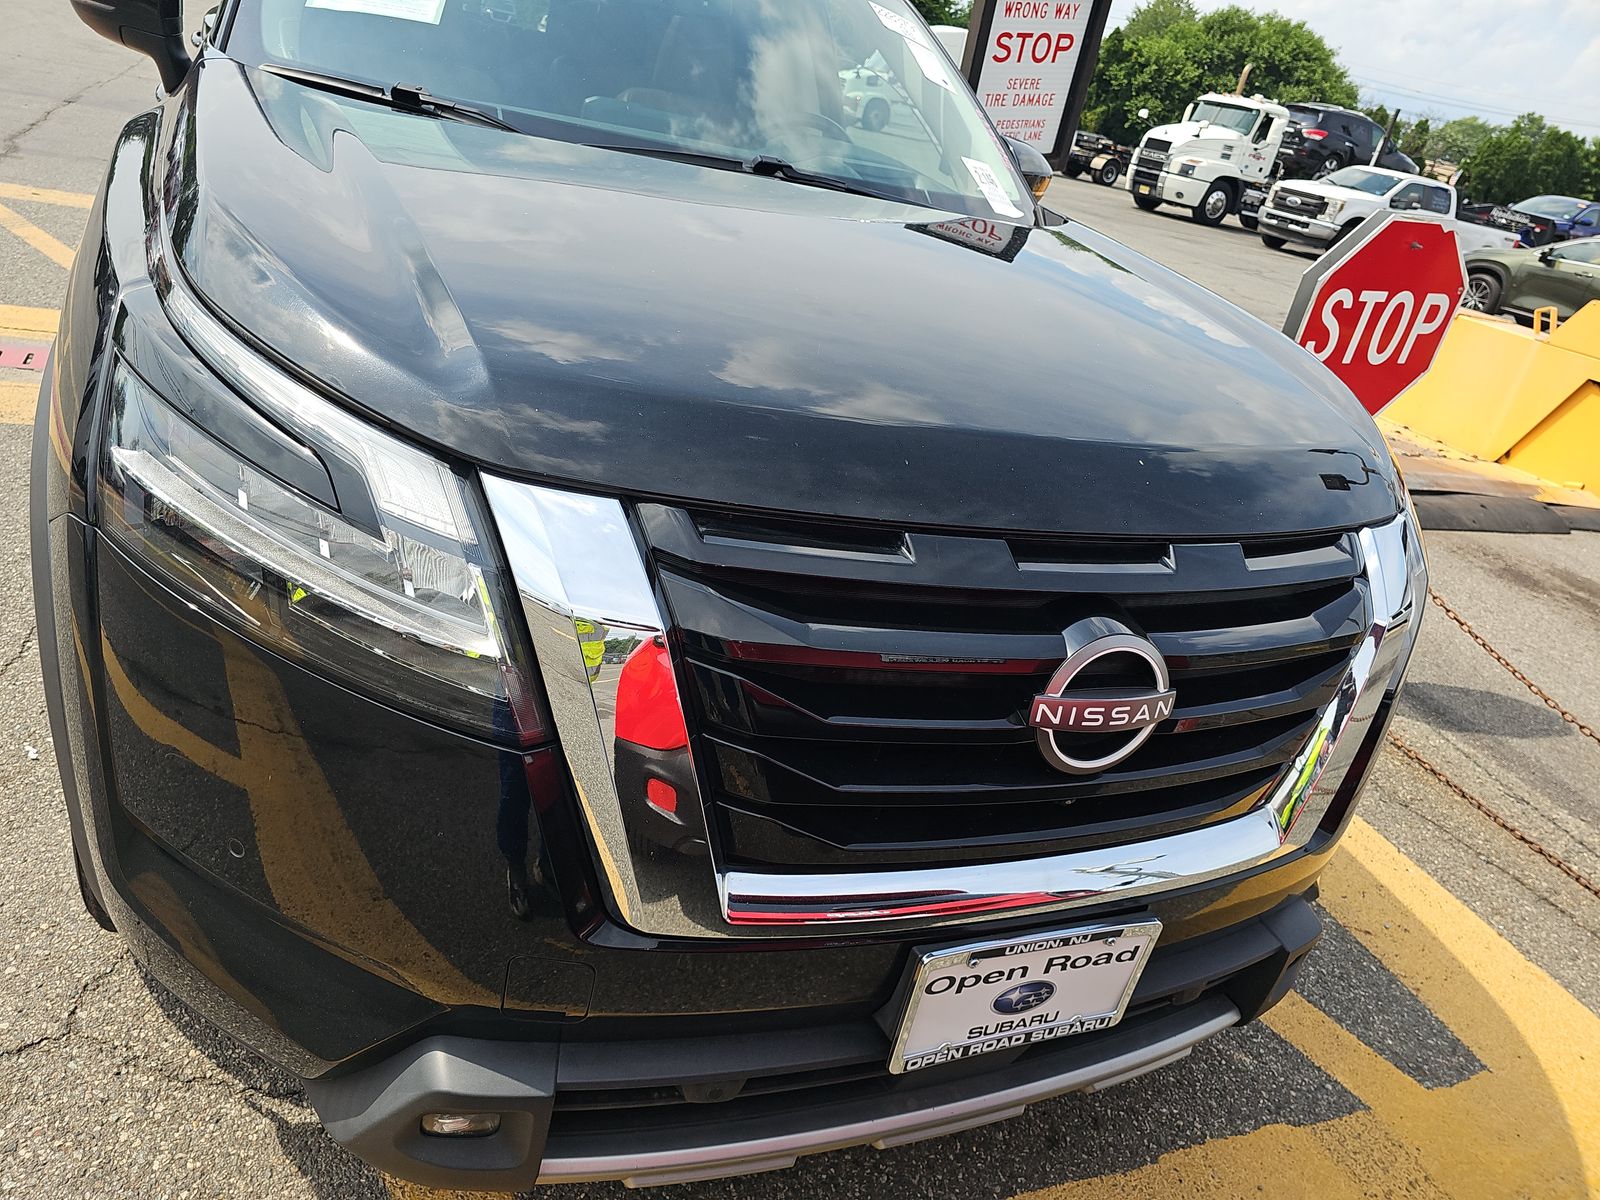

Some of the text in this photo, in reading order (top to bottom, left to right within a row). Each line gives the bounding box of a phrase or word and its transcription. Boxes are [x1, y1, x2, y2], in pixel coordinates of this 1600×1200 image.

[1004, 2, 1081, 19] WRONG WAY
[992, 32, 1075, 64] STOP
[1006, 78, 1042, 90] SEVERE
[985, 93, 1056, 107] TIRE DAMAGE
[996, 119, 1046, 130] PEDESTRIANS
[1023, 131, 1043, 141] LANE
[1304, 287, 1450, 366] STOP
[1035, 697, 1173, 727] NISSAN
[1004, 934, 1093, 956] UNION, NJ
[924, 945, 1141, 996] Open Road
[966, 1011, 1060, 1040] SUBARU
[906, 1016, 1111, 1071] OPEN ROAD SUBARU
